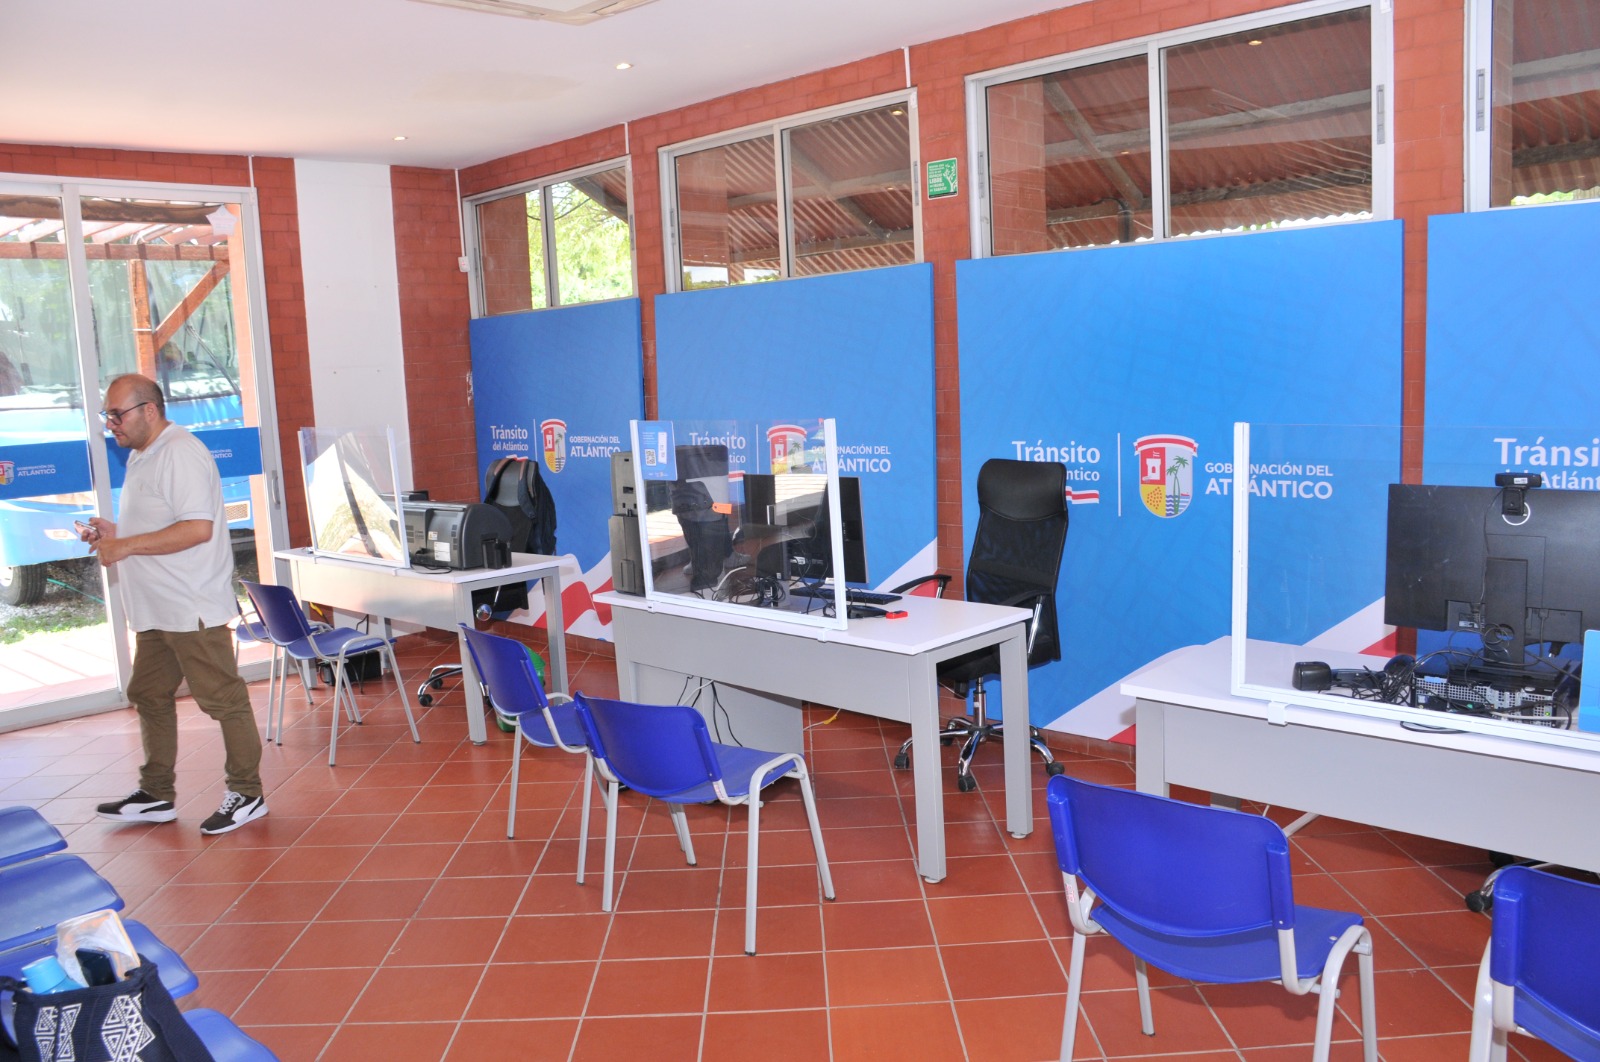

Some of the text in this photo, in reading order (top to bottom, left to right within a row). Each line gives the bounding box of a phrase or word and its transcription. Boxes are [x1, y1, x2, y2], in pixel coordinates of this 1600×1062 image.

[490, 424, 528, 440] Tránsito
[569, 435, 620, 443] GOBERNACIÓN DEL
[493, 441, 528, 451] del Atlántico
[689, 431, 746, 449] Tránsito
[874, 445, 891, 454] DEL
[1012, 440, 1100, 463] Tránsito
[812, 454, 891, 473] ATÁNTICO
[1204, 462, 1333, 476] GOBNACIÓN DEL
[18, 468, 56, 477] ATLÁNTICO
[1066, 467, 1100, 481] ntico
[1205, 475, 1333, 499] ATÁNTICO
